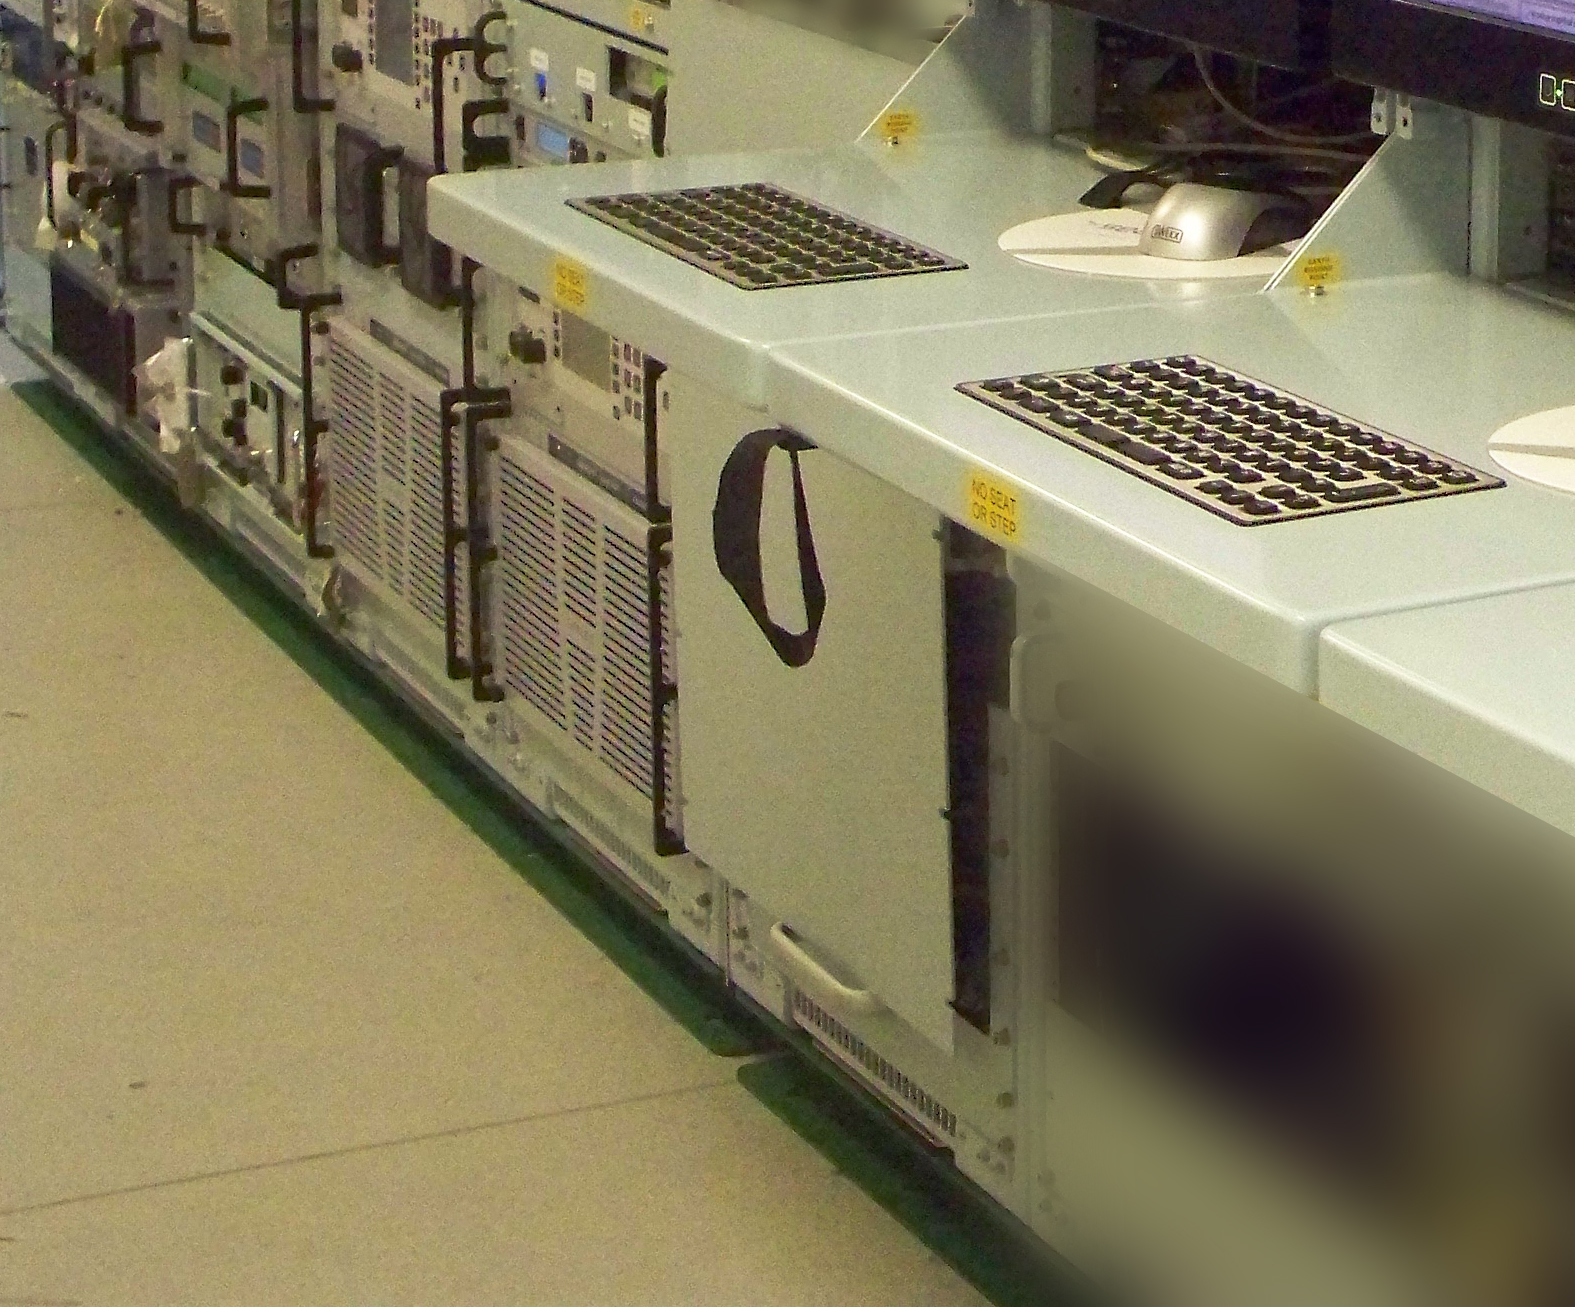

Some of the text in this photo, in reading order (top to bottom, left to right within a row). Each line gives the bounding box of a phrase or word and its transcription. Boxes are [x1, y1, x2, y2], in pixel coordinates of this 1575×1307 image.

[972, 480, 1016, 515] NO SEAT
[972, 502, 1016, 536] OR STEP
